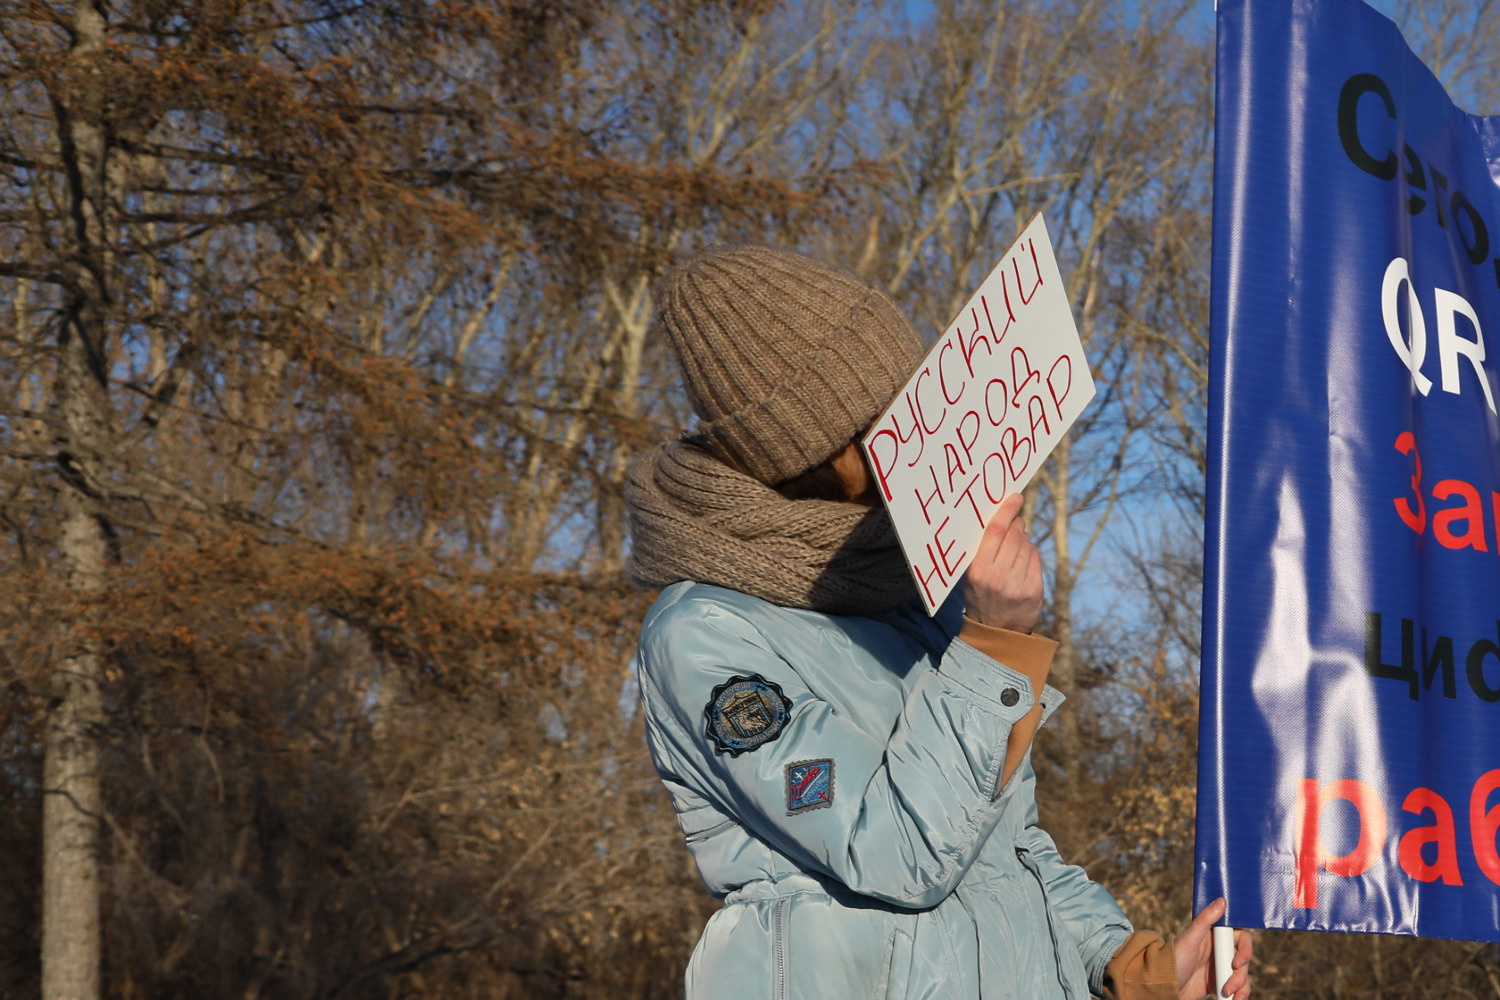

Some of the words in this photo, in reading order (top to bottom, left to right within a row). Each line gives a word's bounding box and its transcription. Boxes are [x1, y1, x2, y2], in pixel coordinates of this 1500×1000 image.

[867, 237, 1044, 503] РУССКИЙ
[913, 346, 1041, 526] НАРОД
[1382, 257, 1499, 416] QR
[912, 515, 967, 608] НЕ
[953, 353, 1072, 529] ТОВАР
